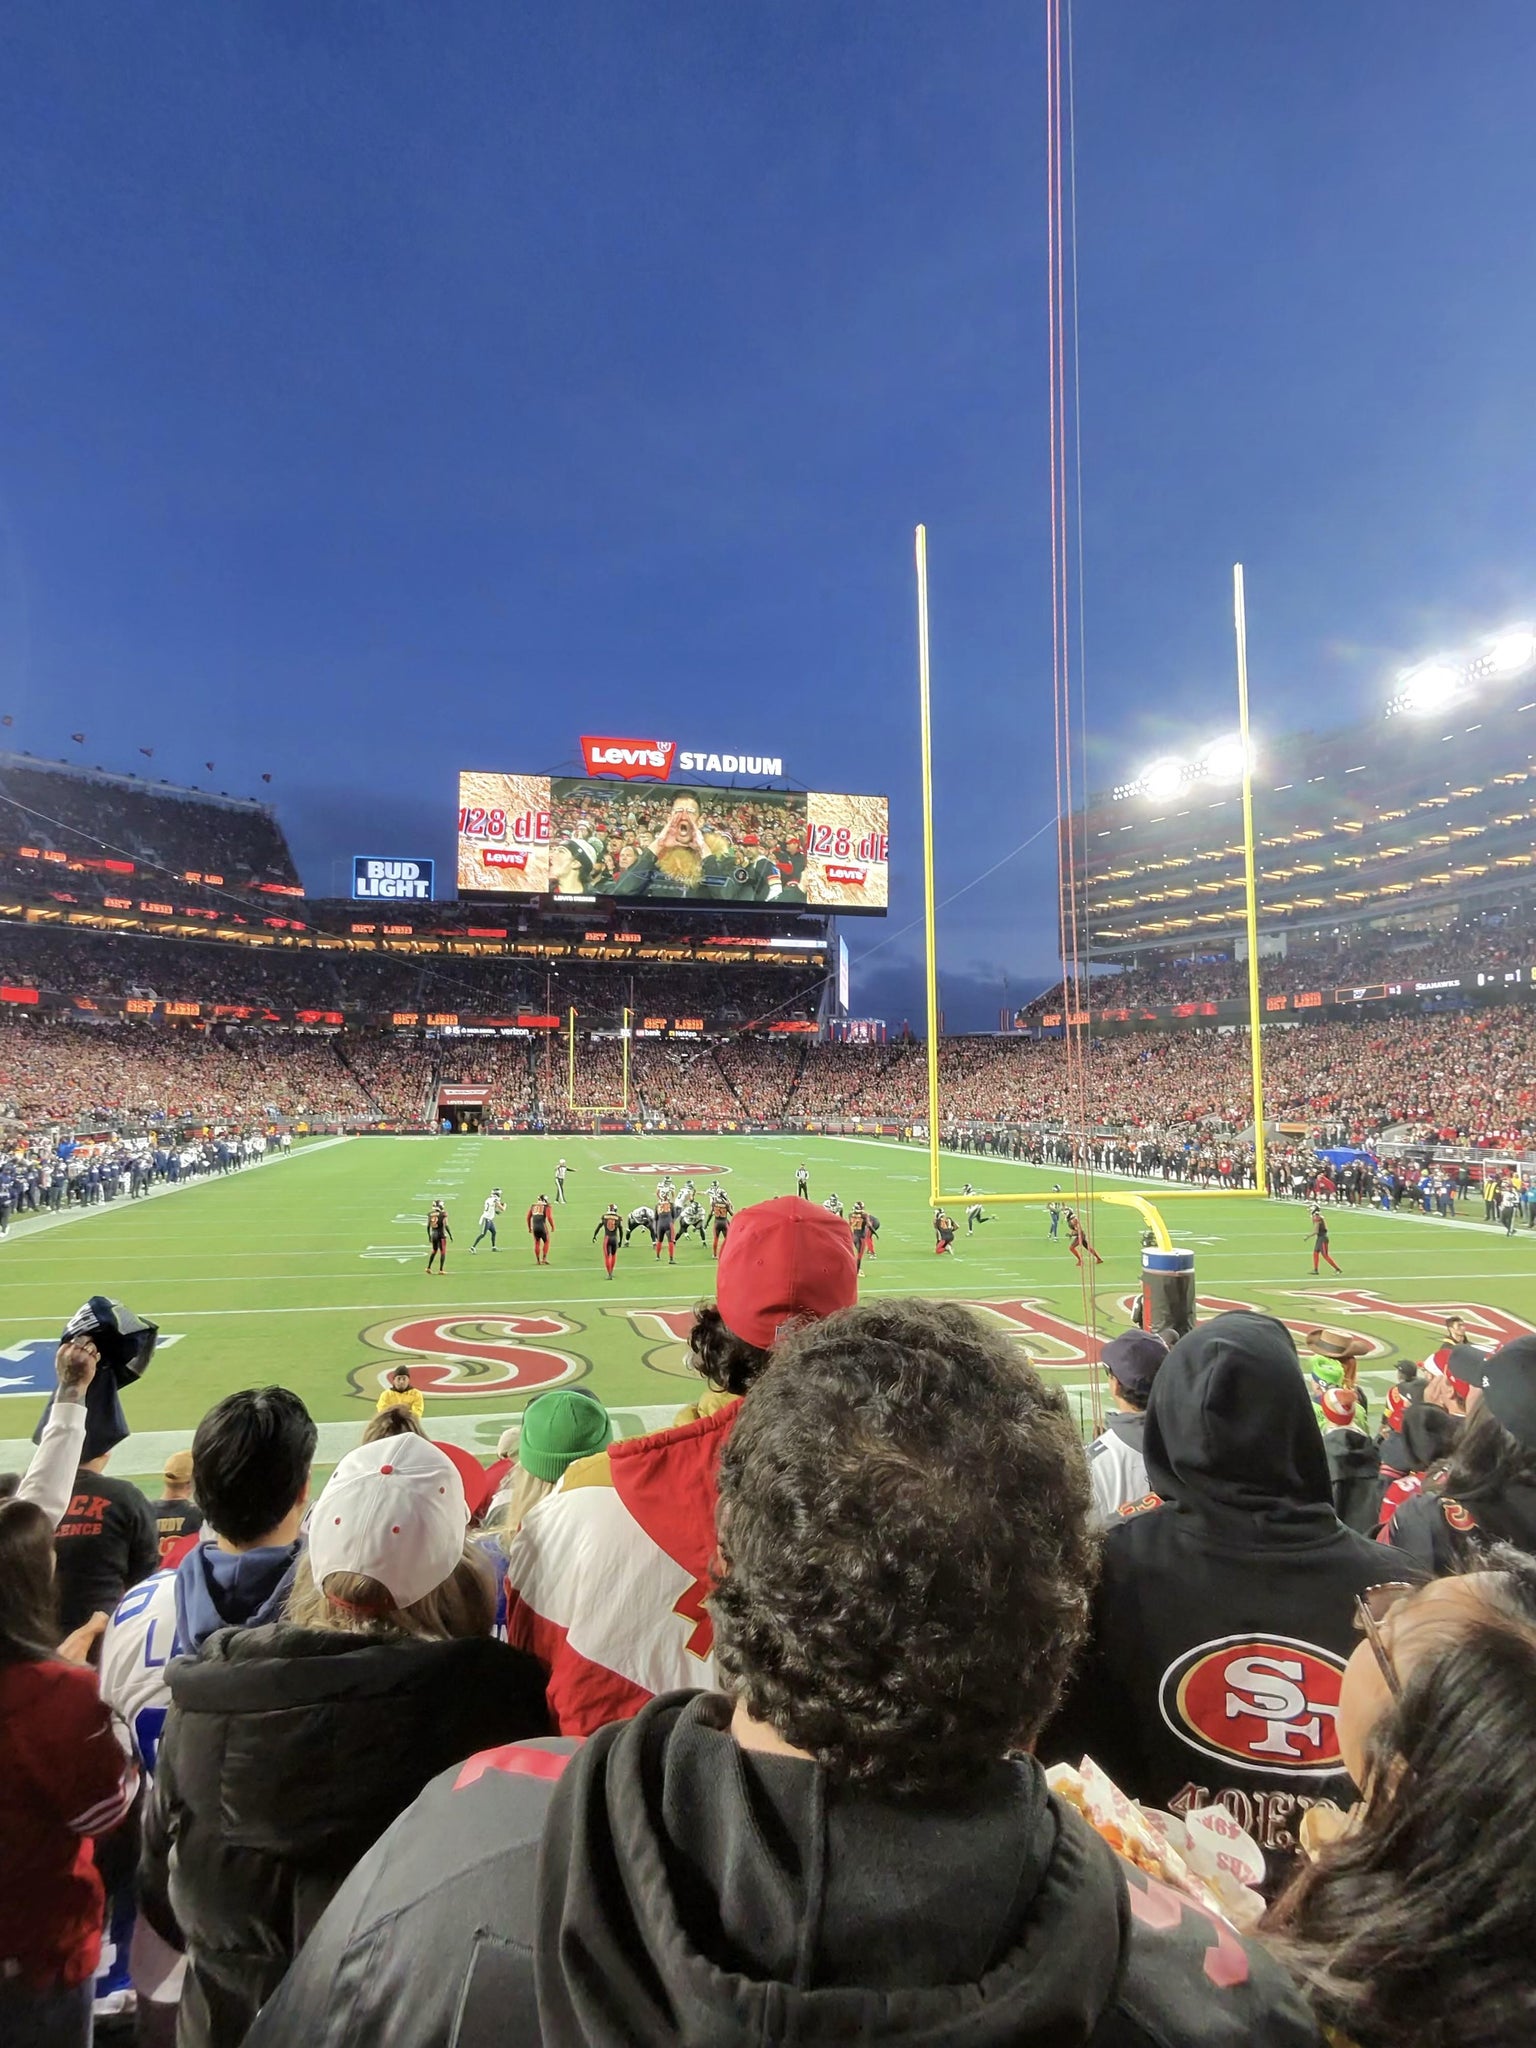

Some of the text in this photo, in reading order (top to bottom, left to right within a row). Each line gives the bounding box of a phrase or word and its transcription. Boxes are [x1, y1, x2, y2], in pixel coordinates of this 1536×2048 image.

[679, 752, 783, 776] STADIUM
[458, 807, 506, 841] 128
[367, 861, 420, 880] BUD
[500, 1027, 529, 1036] verizon
[676, 1029, 697, 1038] NetApp
